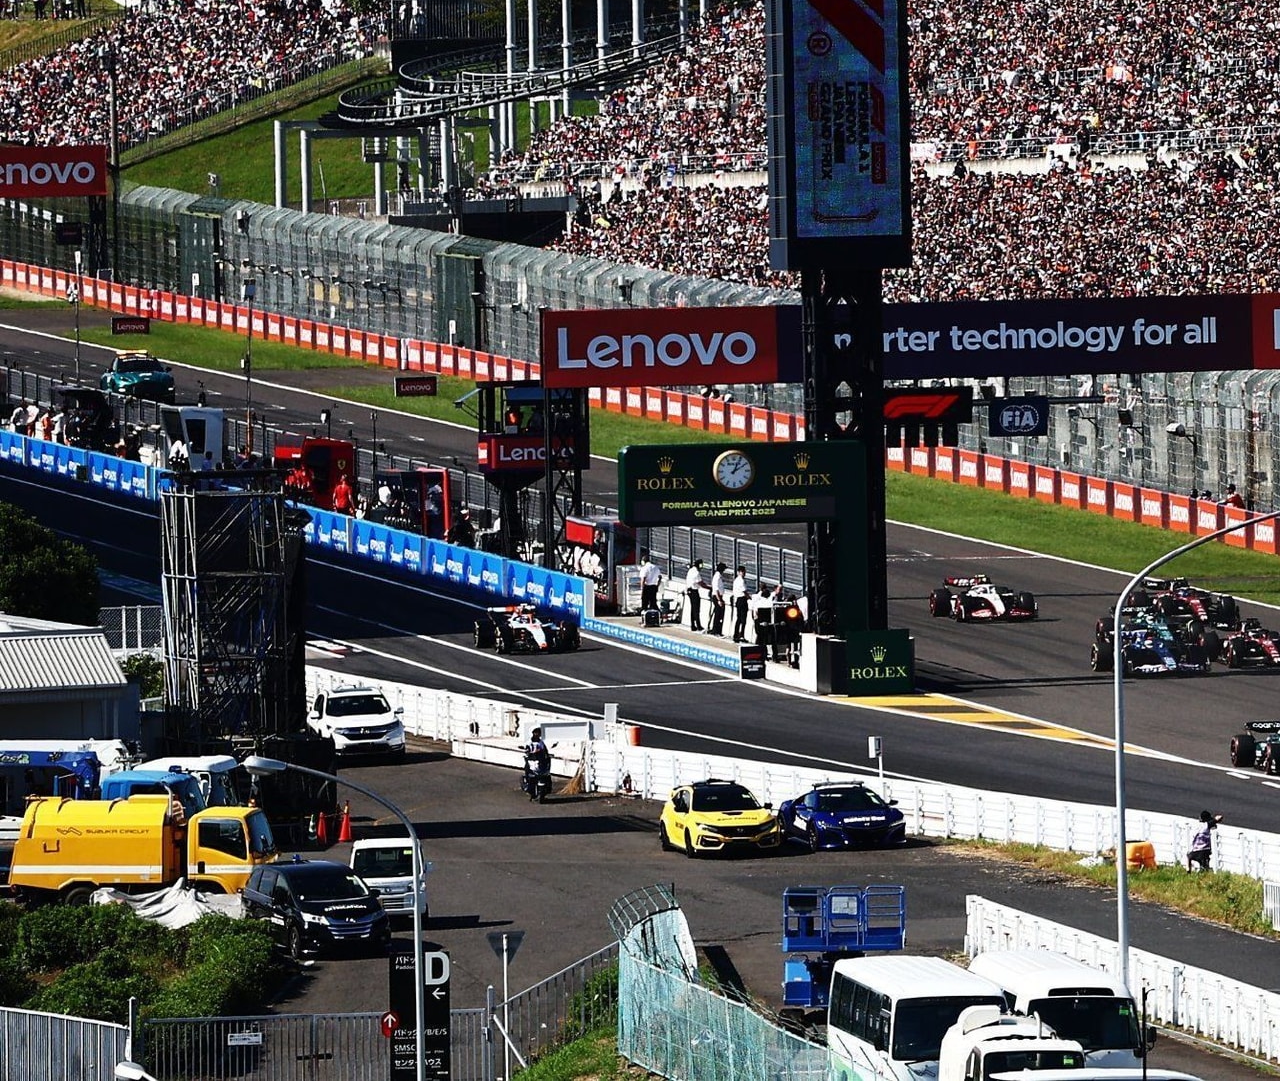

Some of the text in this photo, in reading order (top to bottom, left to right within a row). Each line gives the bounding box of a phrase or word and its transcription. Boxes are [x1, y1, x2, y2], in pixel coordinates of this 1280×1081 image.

[821, 82, 832, 181] GRAND PRIX
[116, 323, 145, 331] Lenovo
[950, 320, 1125, 353] technology
[1132, 318, 1178, 346] for
[1183, 316, 1217, 344] all
[557, 326, 757, 369] Lenovo
[400, 384, 431, 392] Lenovo
[637, 477, 695, 490] ROLEX
[774, 473, 832, 487] ROLEX
[662, 501, 710, 510] FORMULA
[717, 500, 755, 509] LENOVO
[756, 498, 807, 507] JAPANESE
[729, 509, 750, 517] PRIX
[752, 508, 776, 516] 2023
[851, 666, 907, 680] ROLEX
[425, 951, 450, 986] D
[394, 1044, 416, 1052] SMSC
